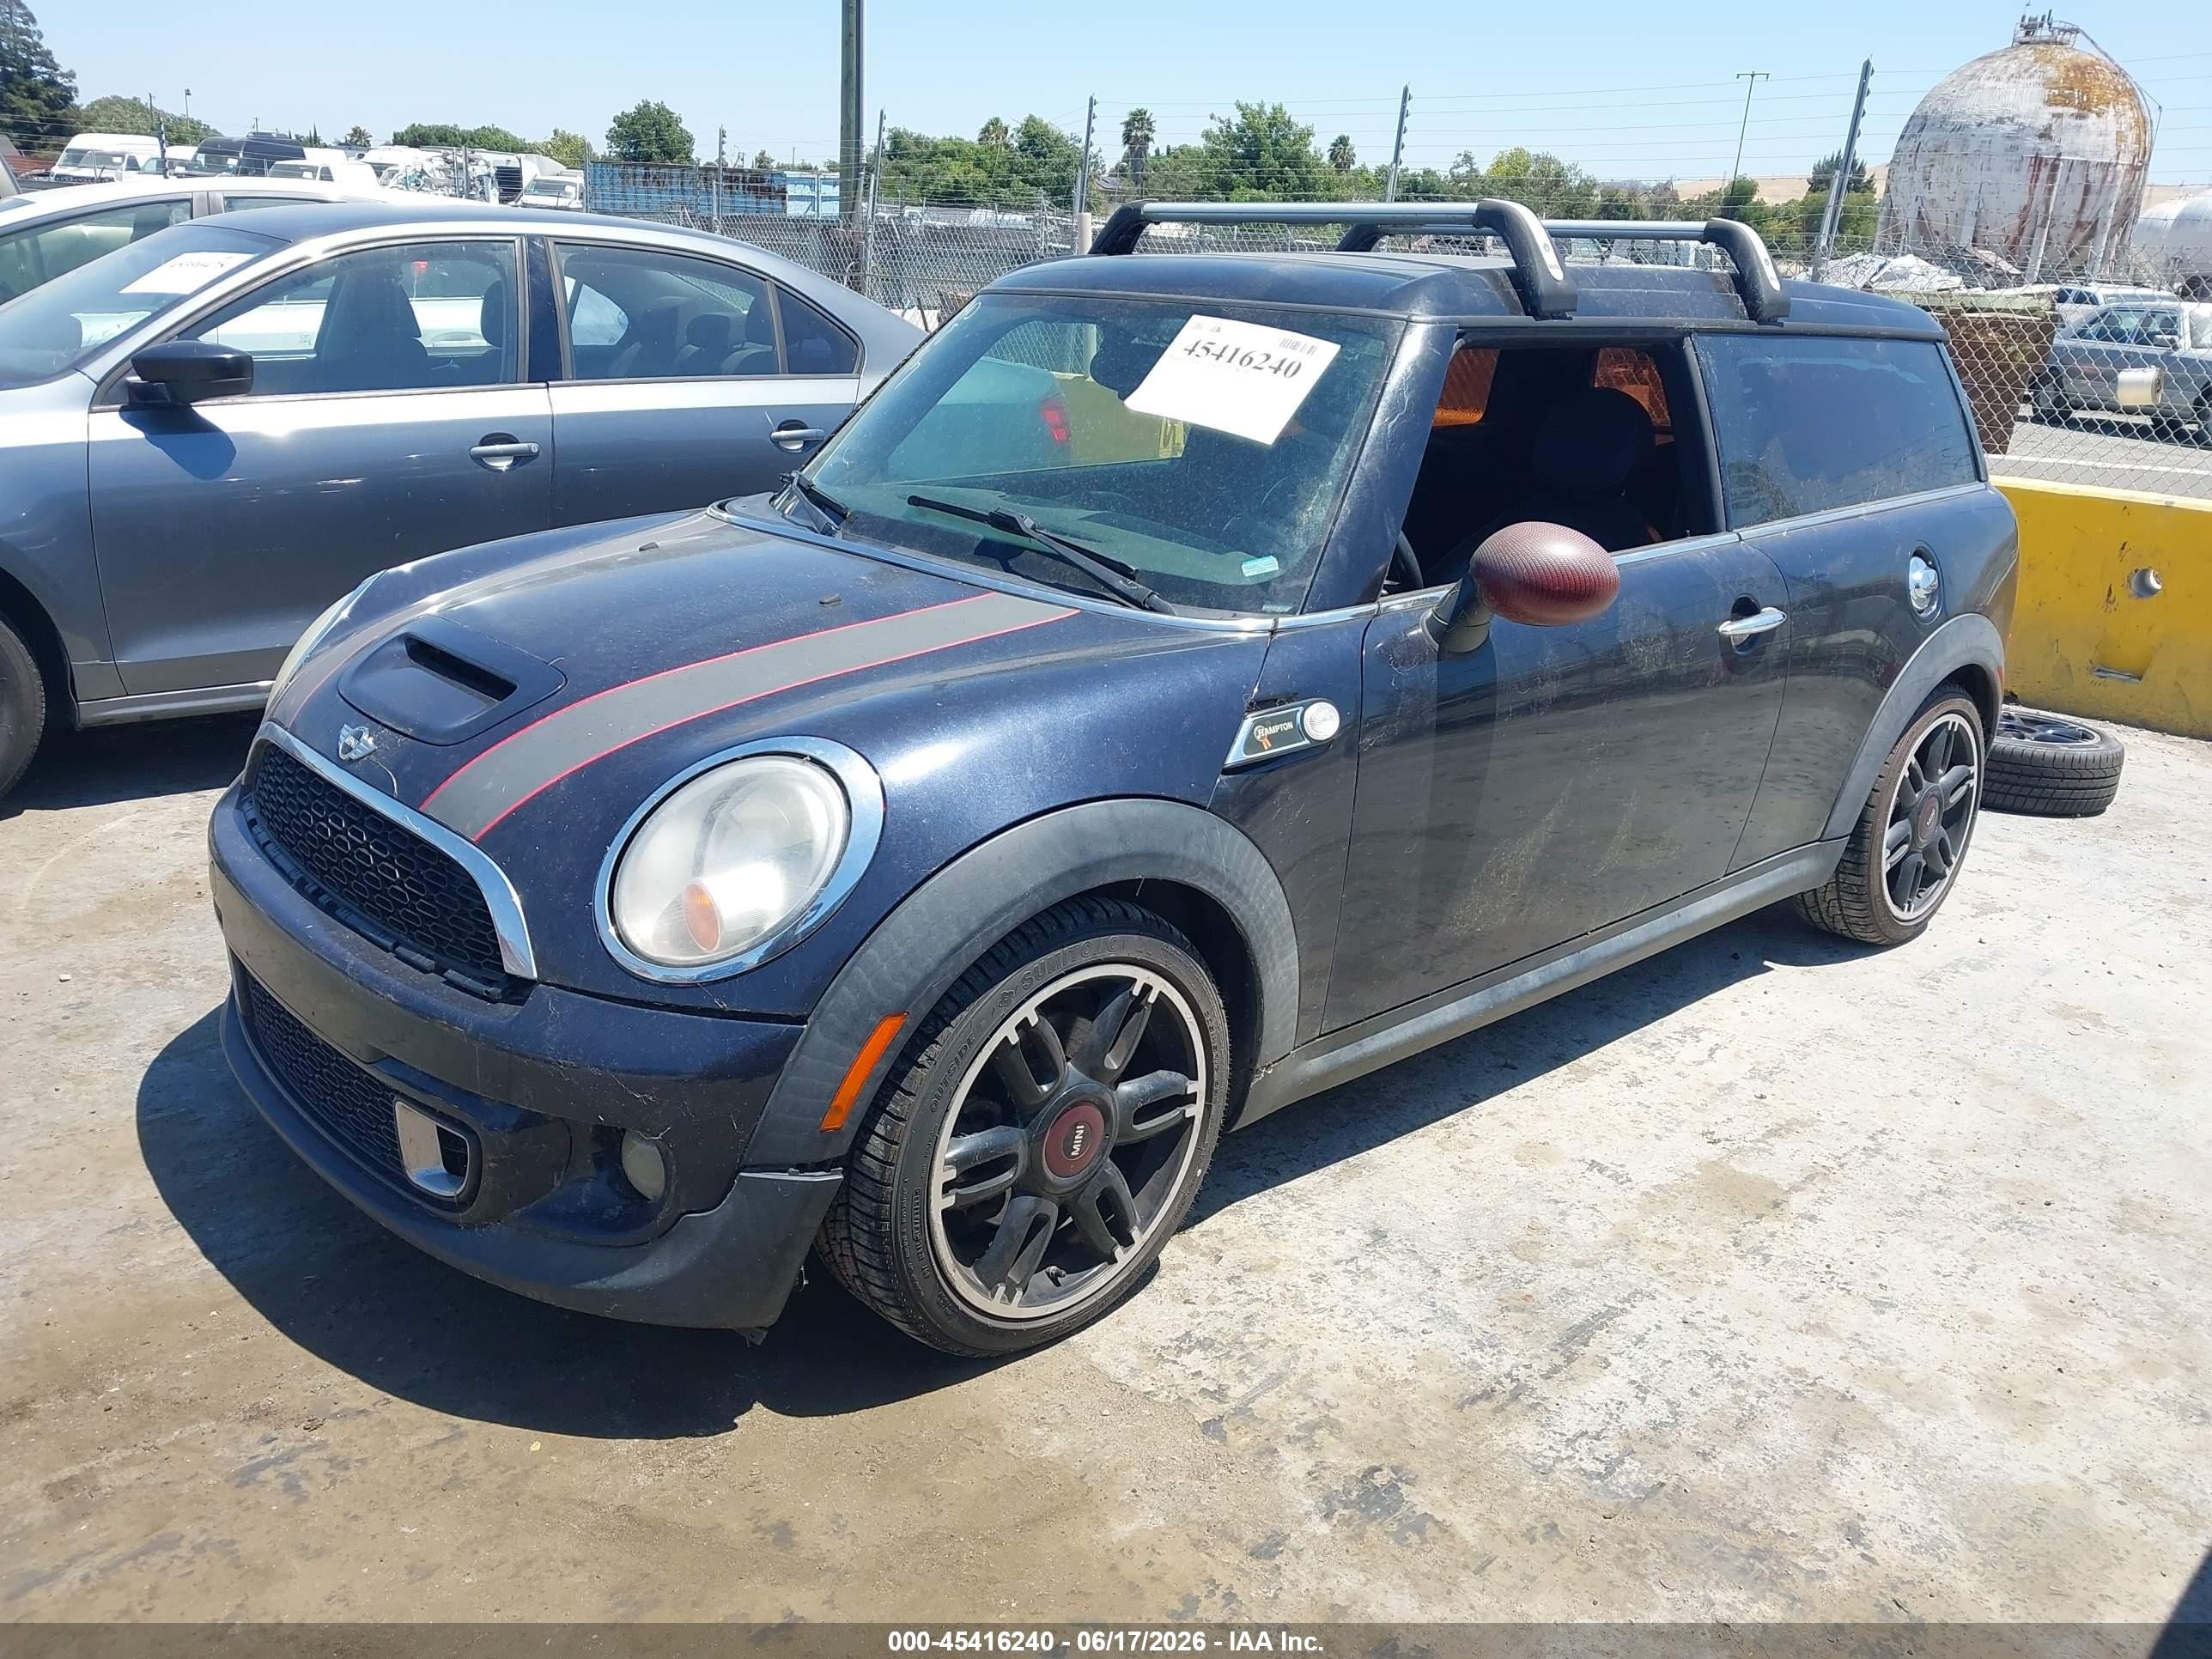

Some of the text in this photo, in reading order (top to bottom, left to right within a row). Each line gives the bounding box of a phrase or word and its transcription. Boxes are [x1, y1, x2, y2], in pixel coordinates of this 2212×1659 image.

[1182, 338, 1303, 380] 45416240
[1257, 720, 1294, 738] HAMPTON
[930, 1032, 976, 1113] OUTSIDE
[1071, 1125, 1085, 1156] MINI
